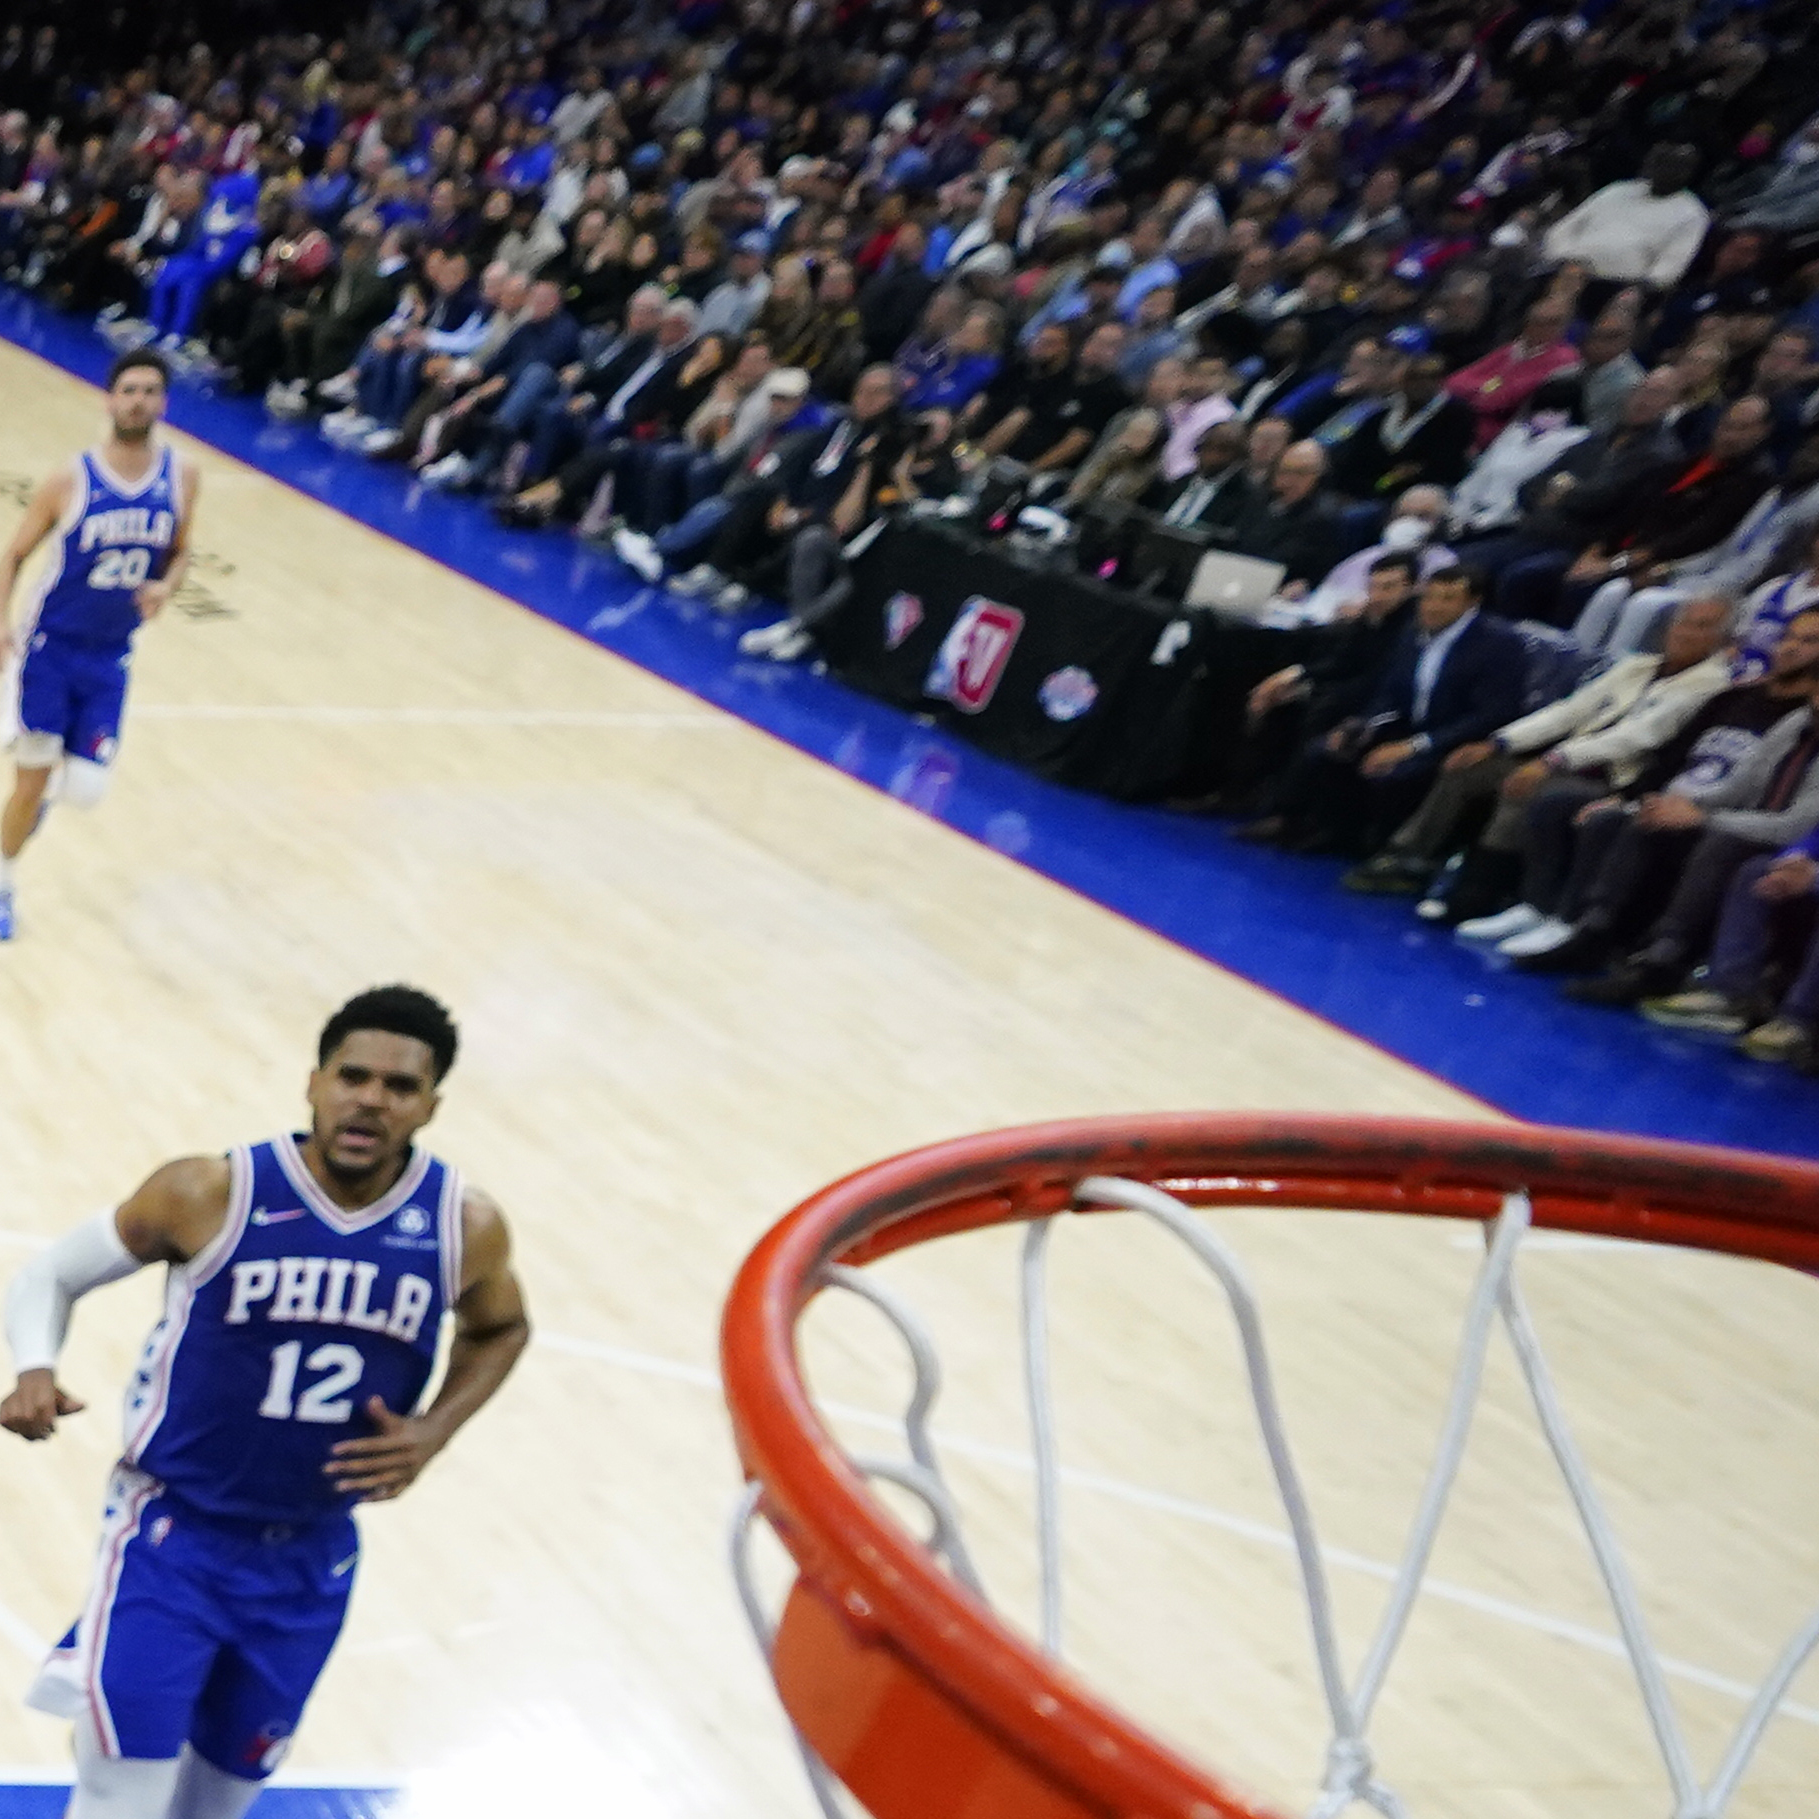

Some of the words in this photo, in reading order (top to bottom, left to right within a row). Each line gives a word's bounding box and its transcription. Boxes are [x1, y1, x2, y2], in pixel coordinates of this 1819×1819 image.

[78, 507, 174, 554] PHILA
[87, 548, 151, 590] 20
[223, 1256, 434, 1344] PHILA
[258, 1340, 366, 1425] 12
